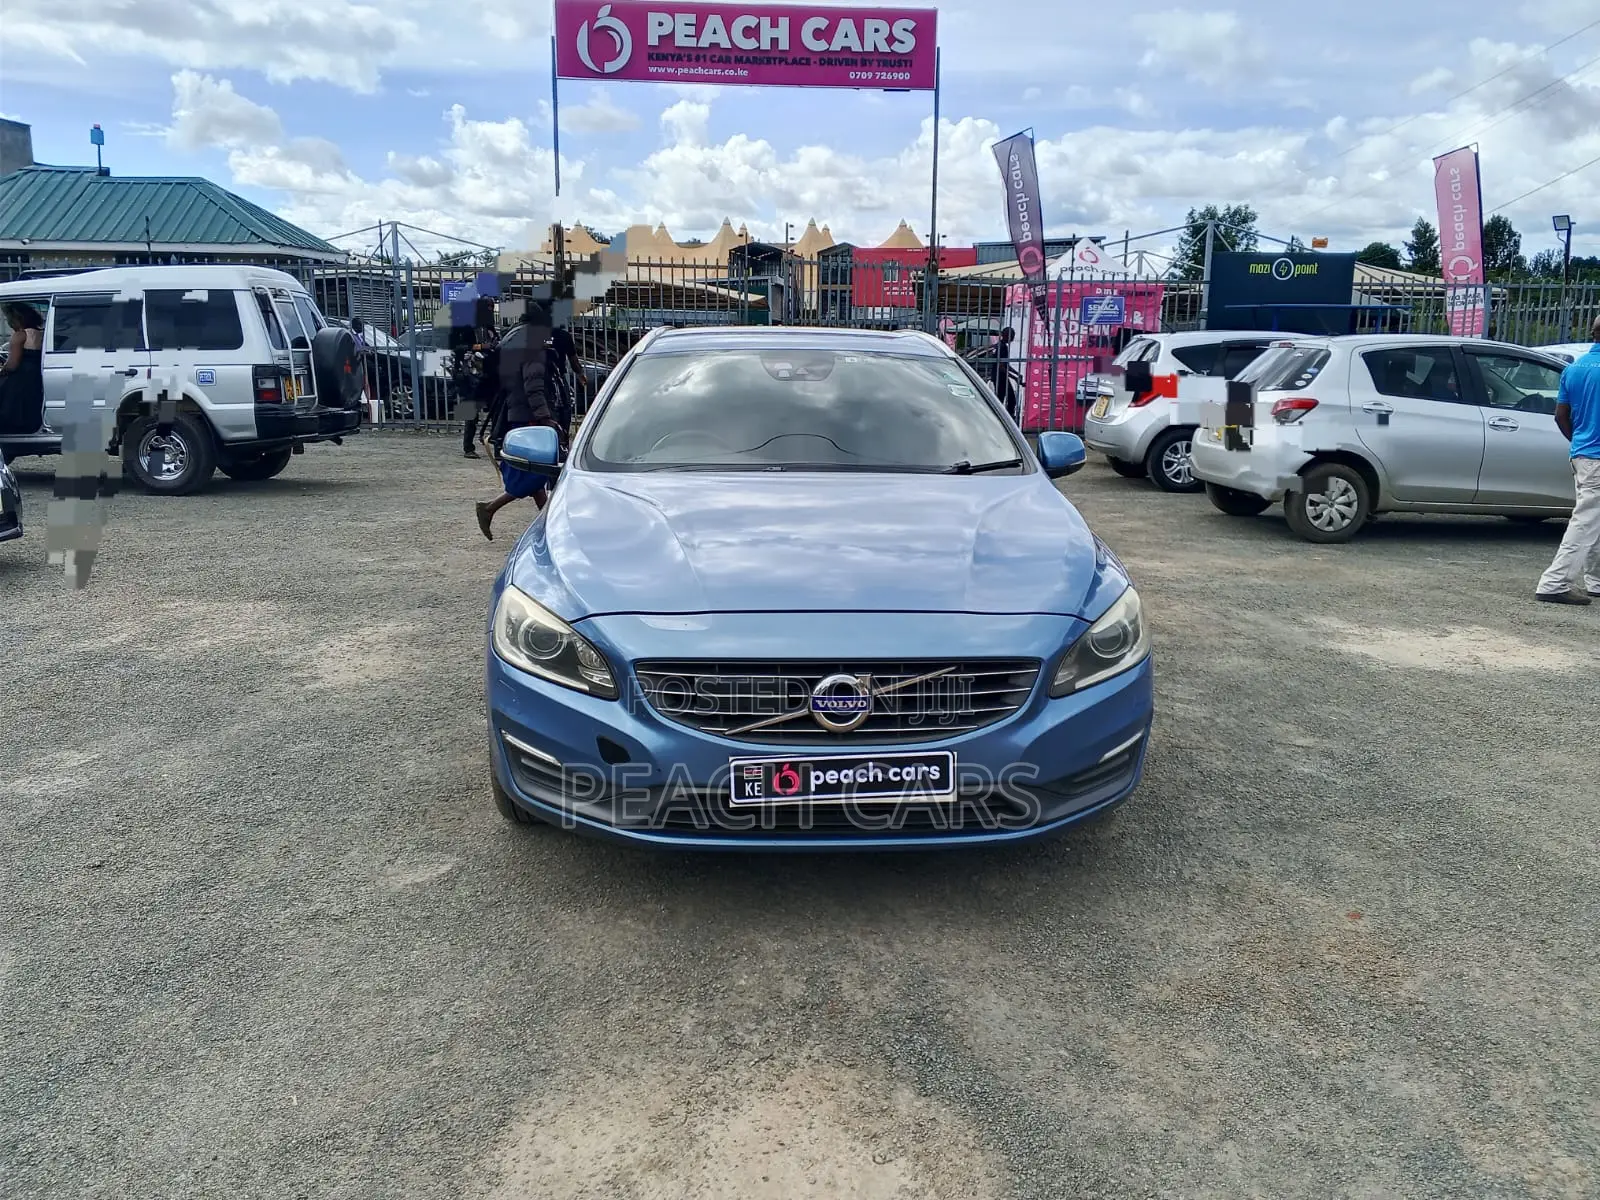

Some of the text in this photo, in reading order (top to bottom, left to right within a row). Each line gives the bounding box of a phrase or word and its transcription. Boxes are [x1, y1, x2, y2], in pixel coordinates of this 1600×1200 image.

[647, 11, 917, 54] PEACH CARS
[647, 52, 693, 62] KENYA'S
[709, 54, 732, 64] CAR
[734, 55, 811, 66] MARKETPLACE
[819, 57, 858, 67] DRIVEN
[860, 58, 873, 67] BY
[648, 65, 749, 77] www.peachcars.co.ke
[849, 71, 911, 80] 0709 726900
[1060, 265, 1099, 274] peach
[1249, 262, 1319, 277] mozi point
[814, 699, 868, 709] VOLVO
[810, 762, 941, 791] peach cars
[744, 782, 763, 797] KE
